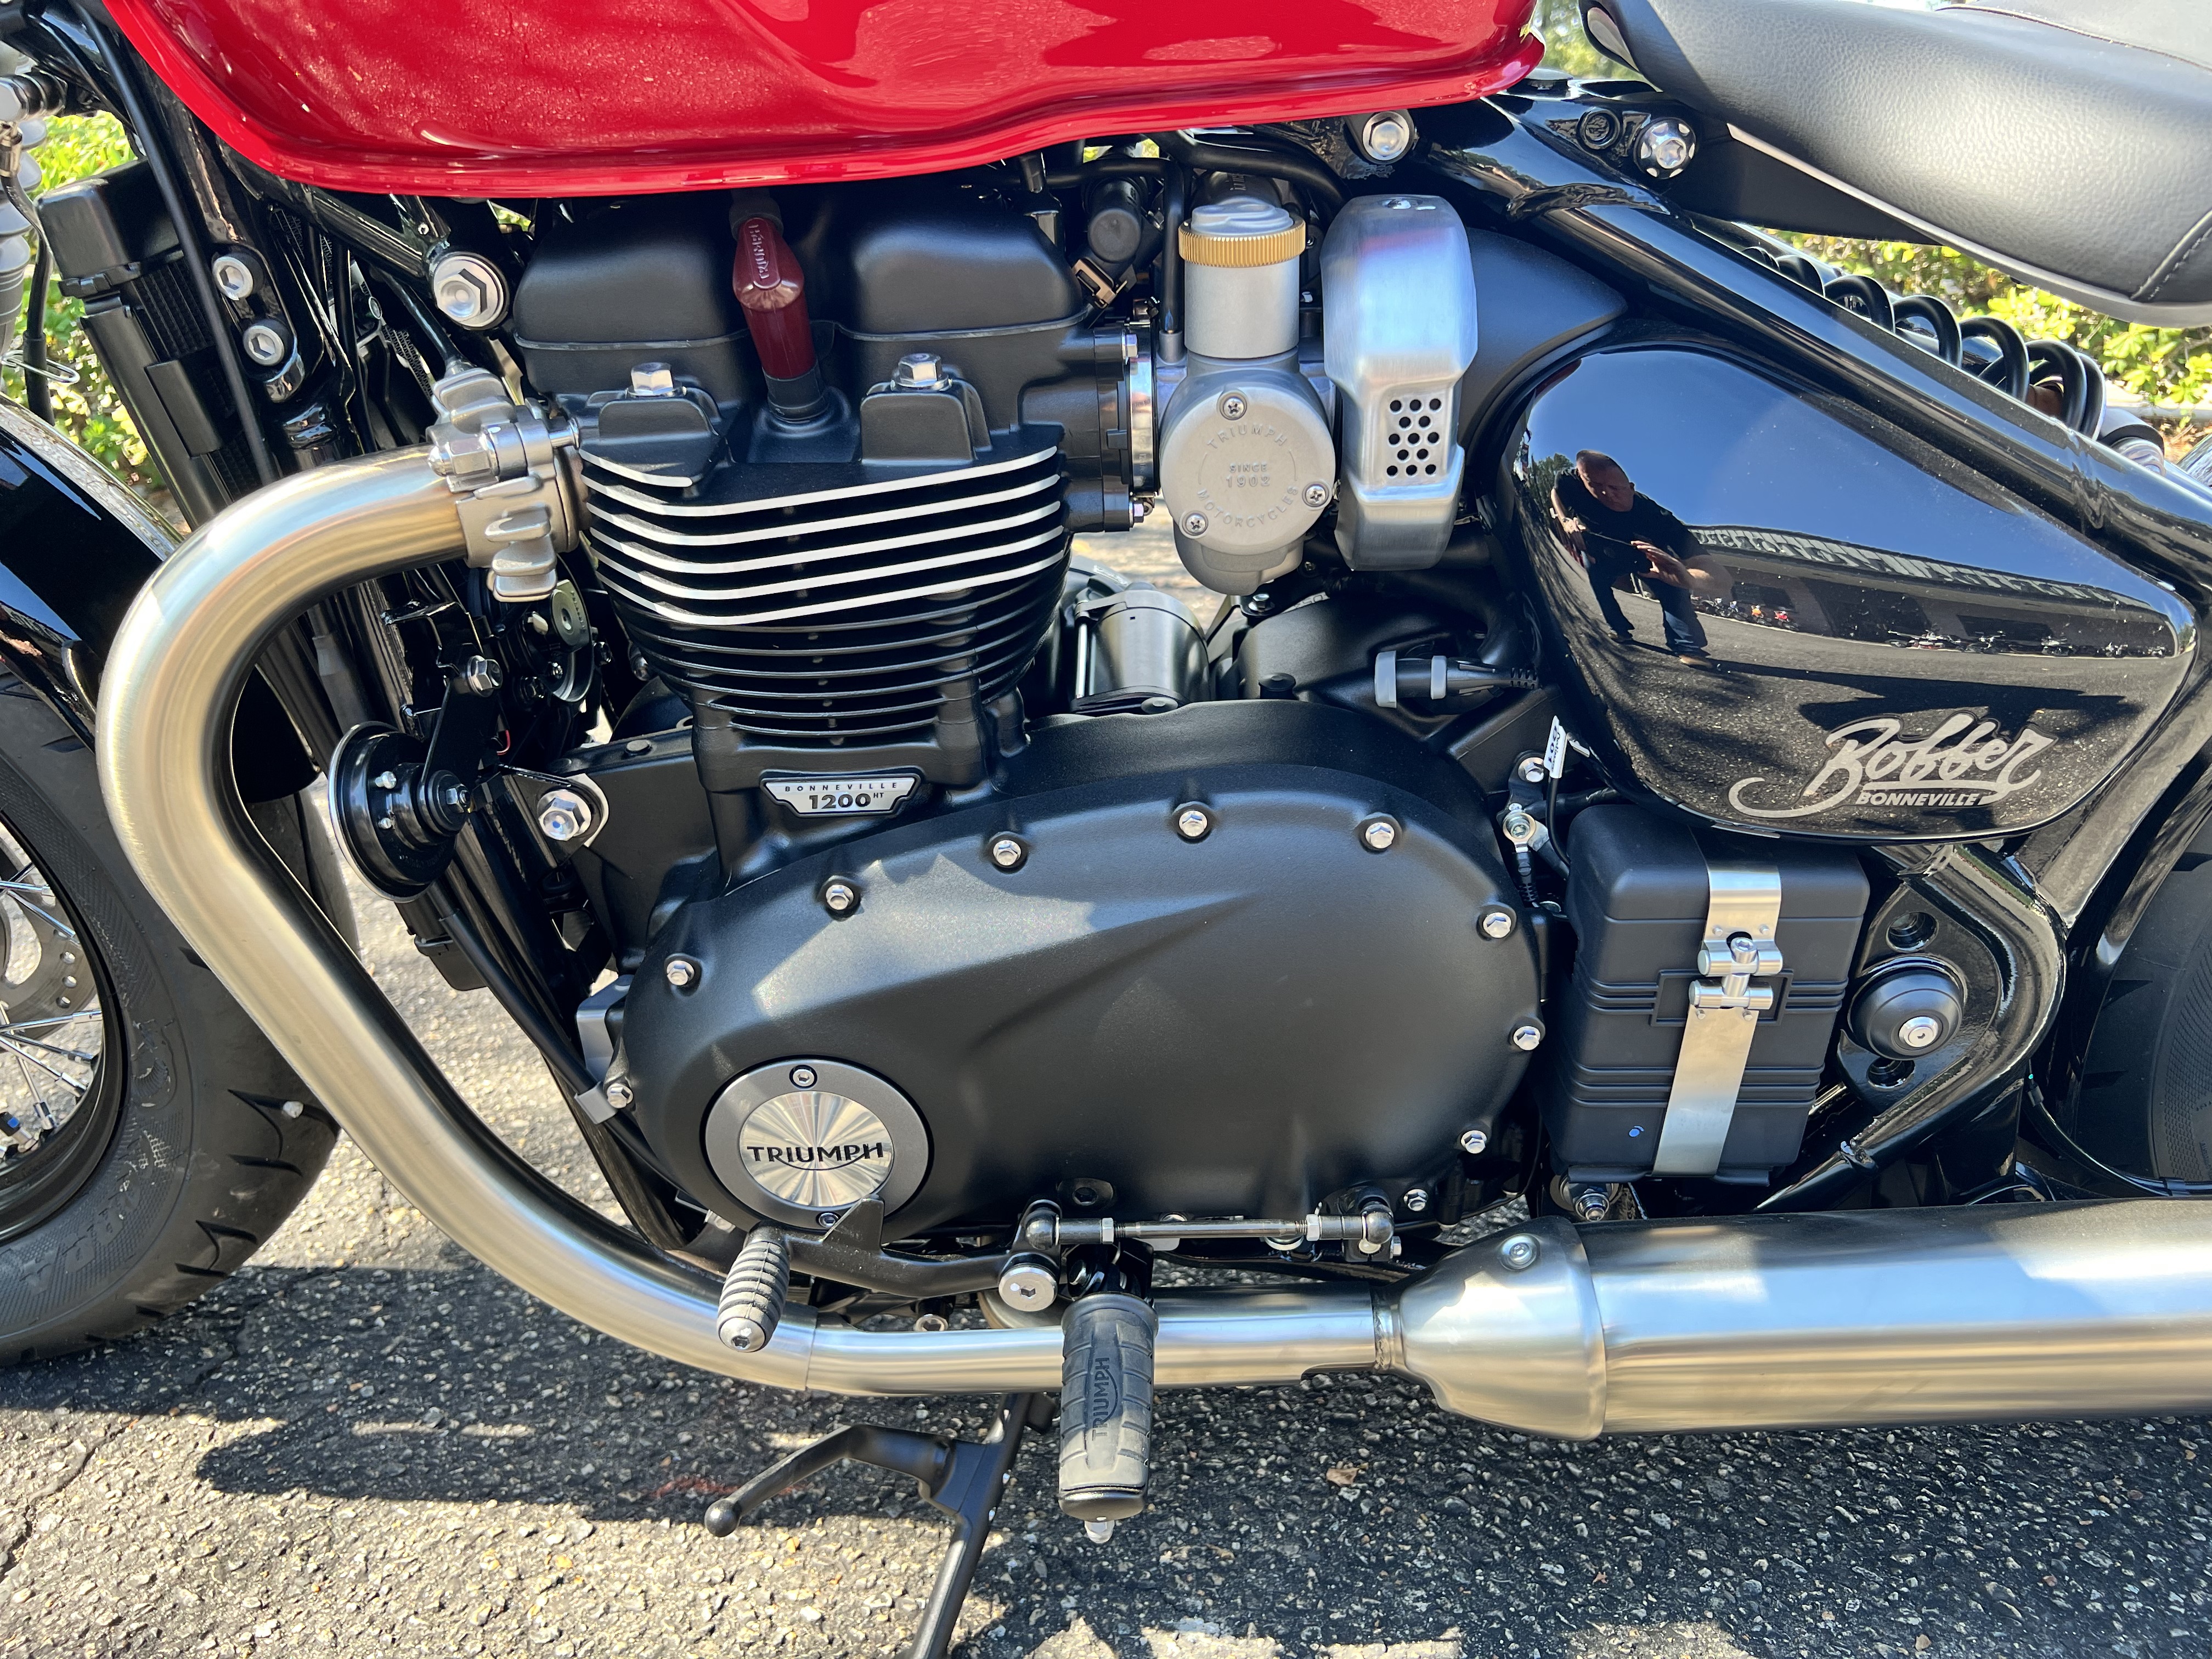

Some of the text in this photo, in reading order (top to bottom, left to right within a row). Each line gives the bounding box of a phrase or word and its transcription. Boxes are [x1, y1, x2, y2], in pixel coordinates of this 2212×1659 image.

[748, 224, 769, 279] TRIUMPH
[1207, 422, 1288, 450] TRIUMPH
[1226, 475, 1271, 488] 1902
[1229, 463, 1268, 473] SINCE
[1197, 485, 1299, 528] MOTORCYCLES
[1729, 713, 2055, 817] Bobber
[785, 783, 896, 792] BONNEVILLE
[1855, 792, 1980, 806] BONNEVILLE
[747, 1142, 883, 1169] TRIUMPH
[1092, 1357, 1117, 1441] TRIUMPH
